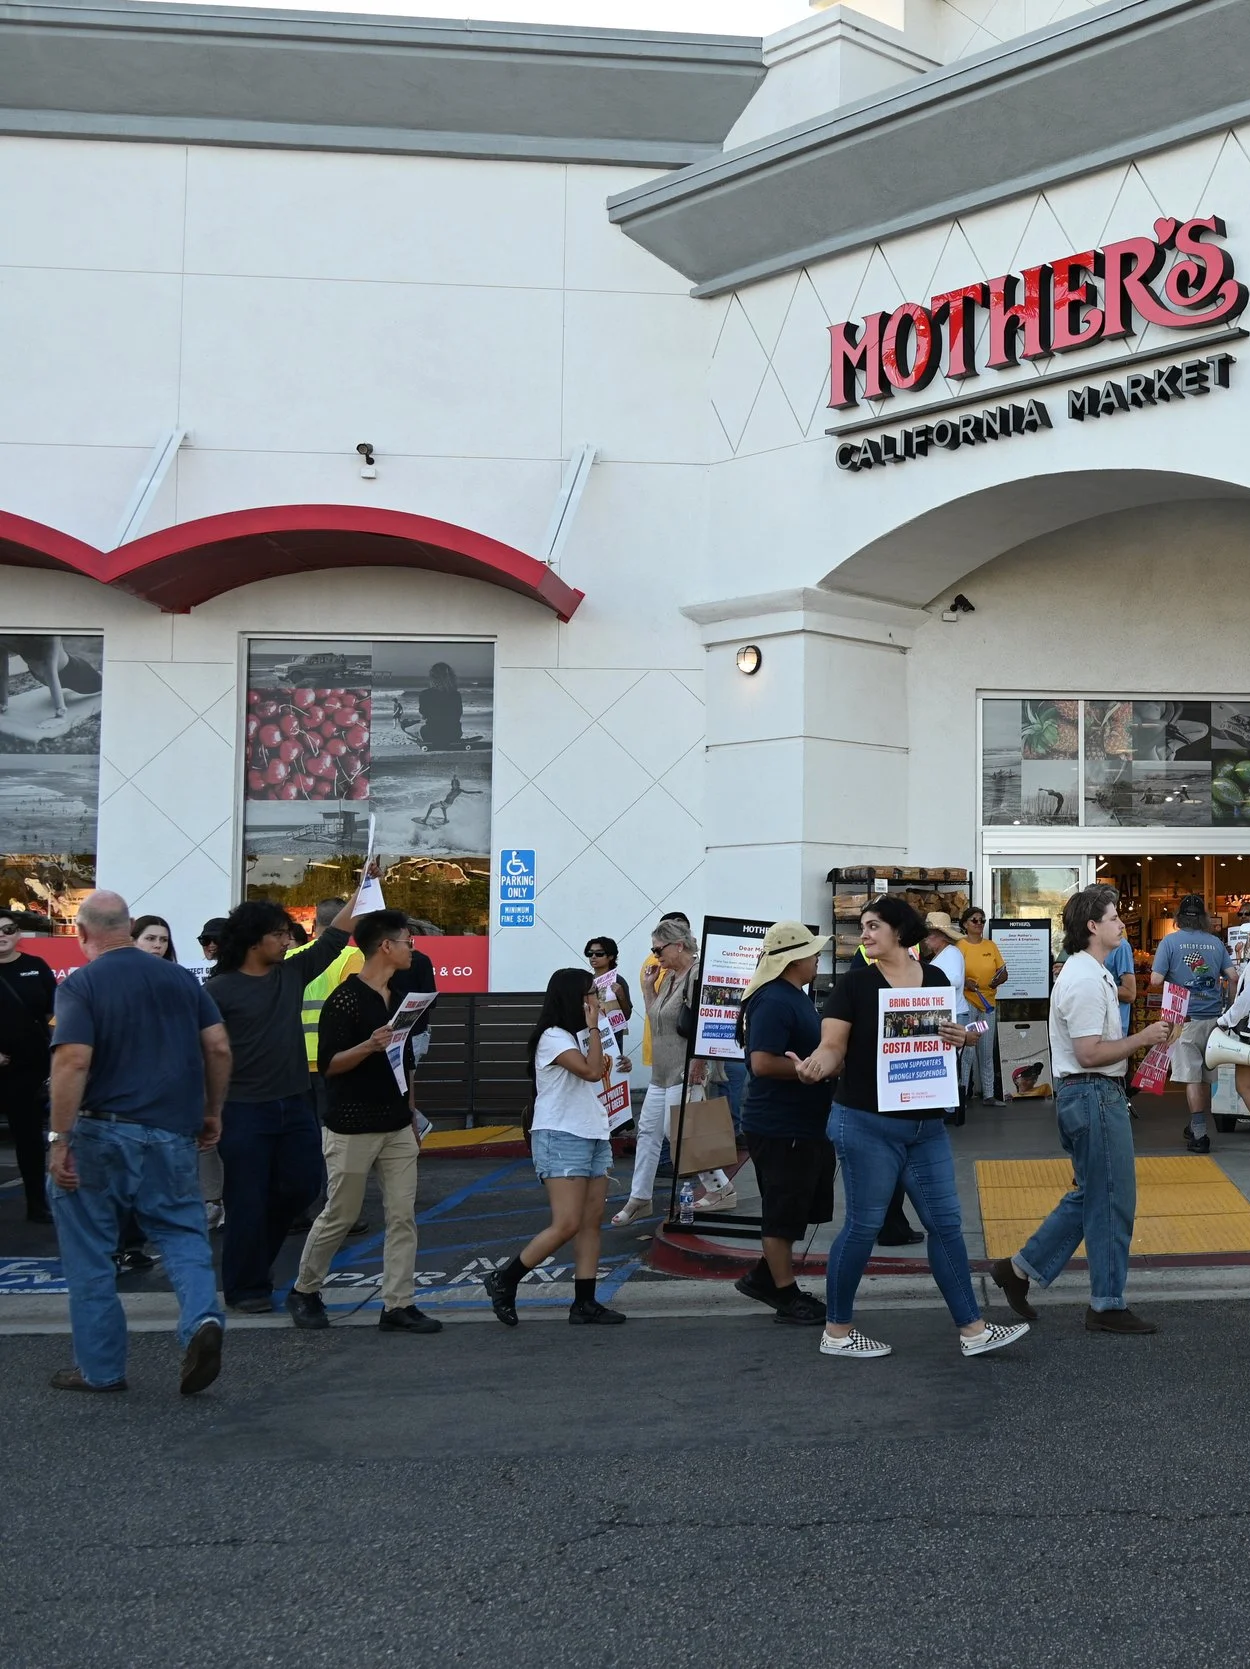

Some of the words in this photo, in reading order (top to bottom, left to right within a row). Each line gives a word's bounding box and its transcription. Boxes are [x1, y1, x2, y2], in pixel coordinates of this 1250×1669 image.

[826, 214, 1249, 410] MOTHER'S
[835, 398, 1053, 472] CALIFORNIA
[1067, 352, 1237, 421] MARKET
[501, 875, 534, 886] PARKING
[507, 887, 528, 898] ONLY
[504, 906, 530, 914] MINIMUM
[501, 915, 514, 923] FINE
[516, 915, 533, 923] $250
[742, 925, 770, 935] MOTHE
[721, 950, 758, 959] Customers
[439, 966, 449, 977] &
[452, 966, 473, 977] GO
[708, 975, 725, 984] BRING
[725, 976, 740, 985] BACK
[889, 998, 910, 1008] BRING
[912, 997, 931, 1007] BACK
[932, 996, 944, 1006] THE
[700, 1007, 722, 1018] COSTA
[724, 1009, 740, 1019] MES
[883, 1041, 911, 1054] COSTA
[913, 1040, 939, 1052] MESA
[890, 1062, 908, 1070] UNION
[909, 1058, 942, 1069] SUPPORTERS
[889, 1071, 915, 1081] WRONGLY
[916, 1068, 947, 1079] SUSPENDED
